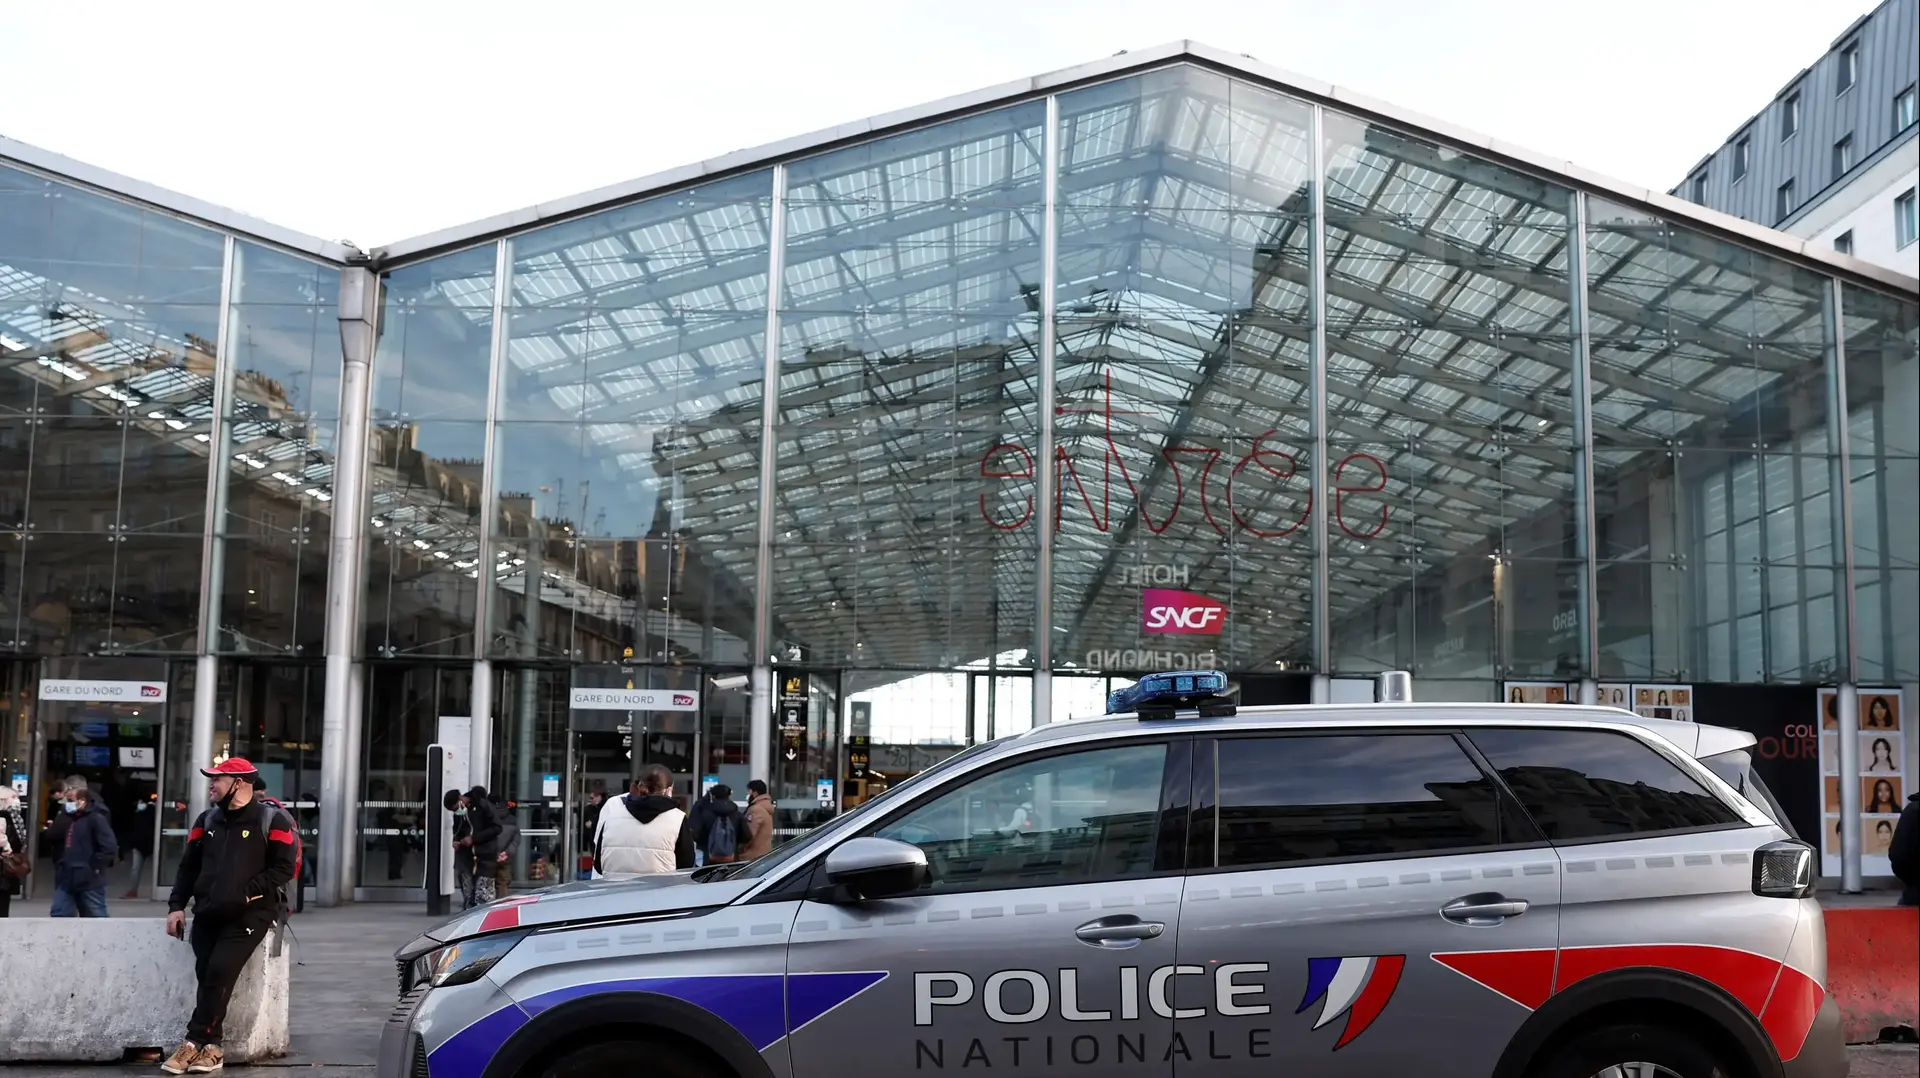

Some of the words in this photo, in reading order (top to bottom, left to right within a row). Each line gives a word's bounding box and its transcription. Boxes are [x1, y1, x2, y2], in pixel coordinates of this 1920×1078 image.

[1146, 606, 1221, 628] SNCF
[44, 685, 73, 695] GARE
[75, 686, 89, 695] DU
[93, 686, 123, 696] NORD
[575, 694, 602, 703] GARE
[606, 694, 620, 703] DU
[624, 695, 655, 704] NORD
[913, 961, 1271, 1026] POLICE
[915, 1028, 1271, 1070] NATIONALE
